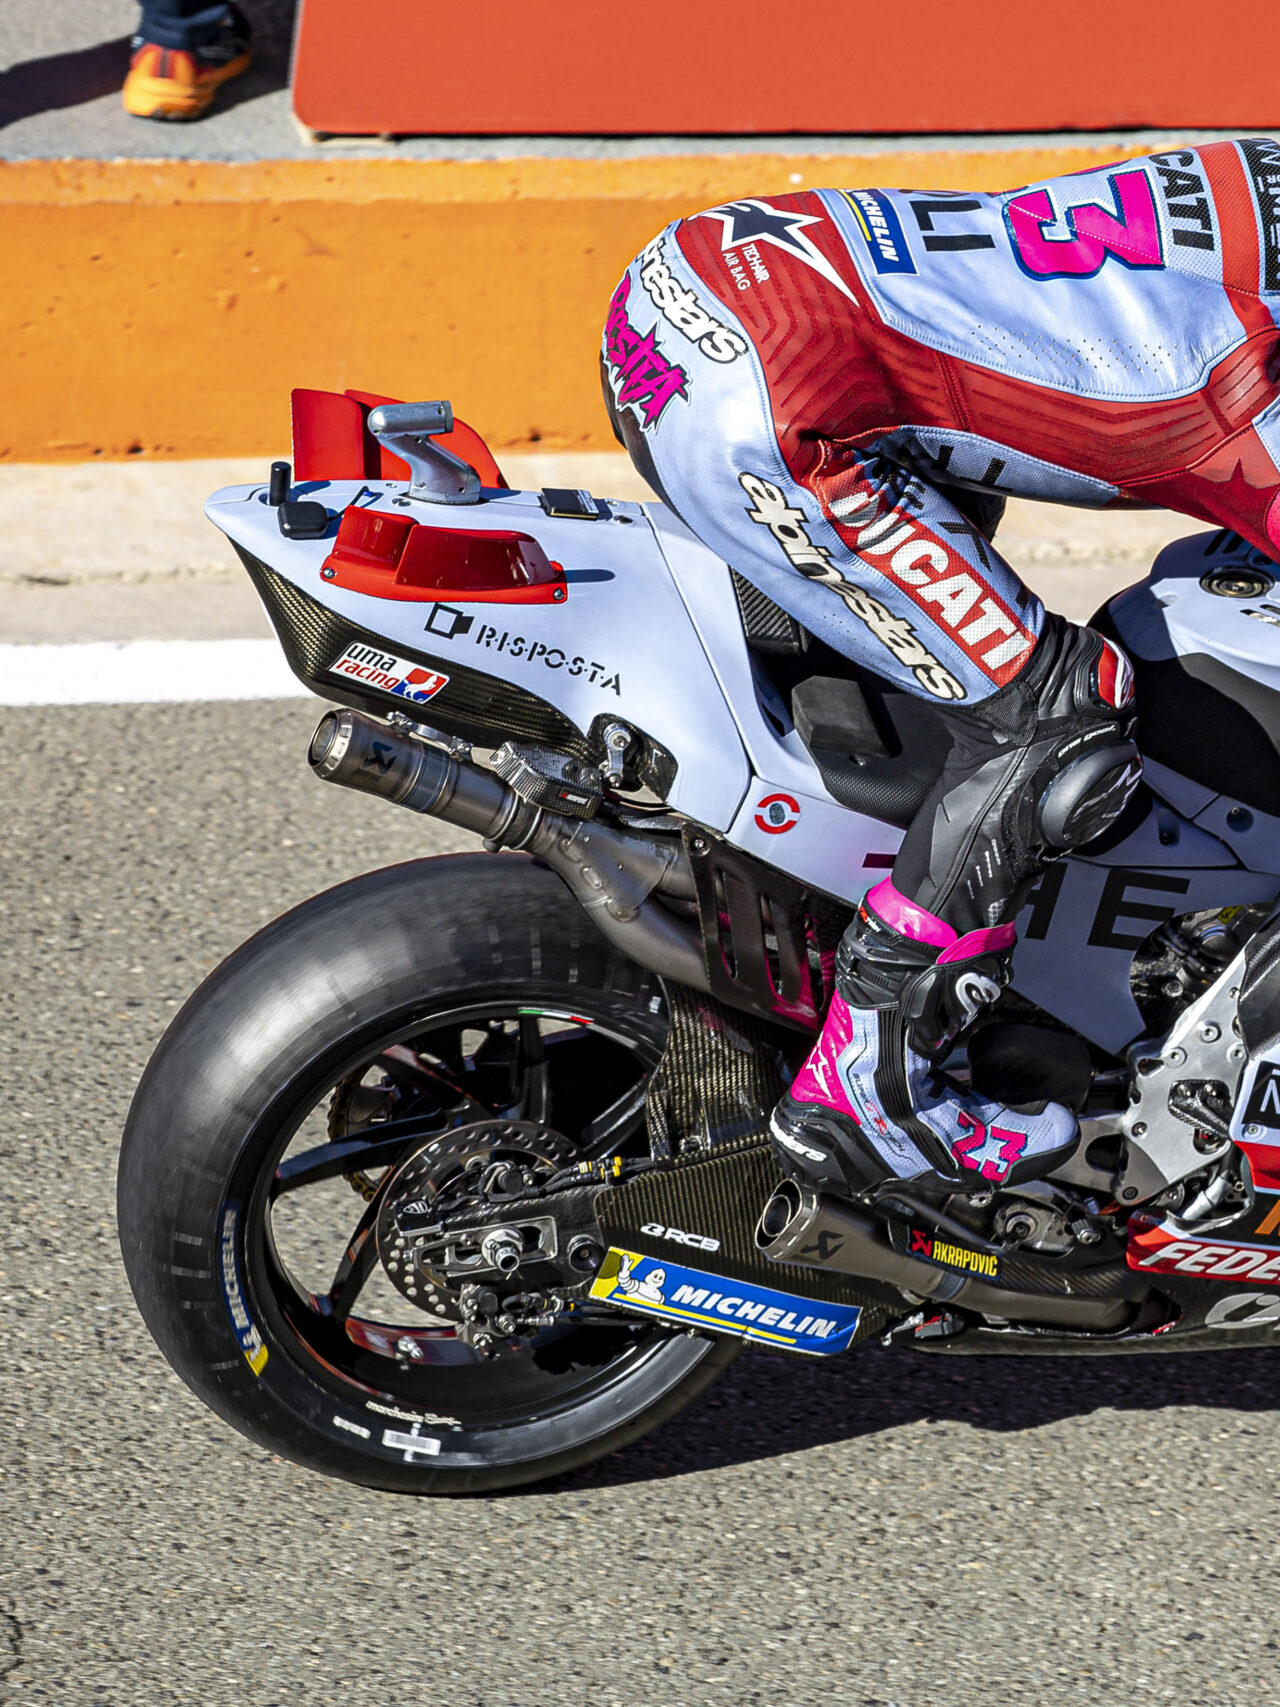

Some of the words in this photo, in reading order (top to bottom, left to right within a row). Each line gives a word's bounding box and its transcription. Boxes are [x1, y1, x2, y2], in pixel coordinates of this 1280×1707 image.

[1000, 160, 1165, 282] 3
[828, 489, 1032, 671] DUCATI
[335, 656, 400, 690] racing
[346, 643, 398, 672] uma
[951, 1111, 1028, 1183] 23
[221, 1208, 250, 1330] MICHELIN
[662, 1226, 722, 1251] RCB
[670, 1283, 838, 1340] MICHELIN
